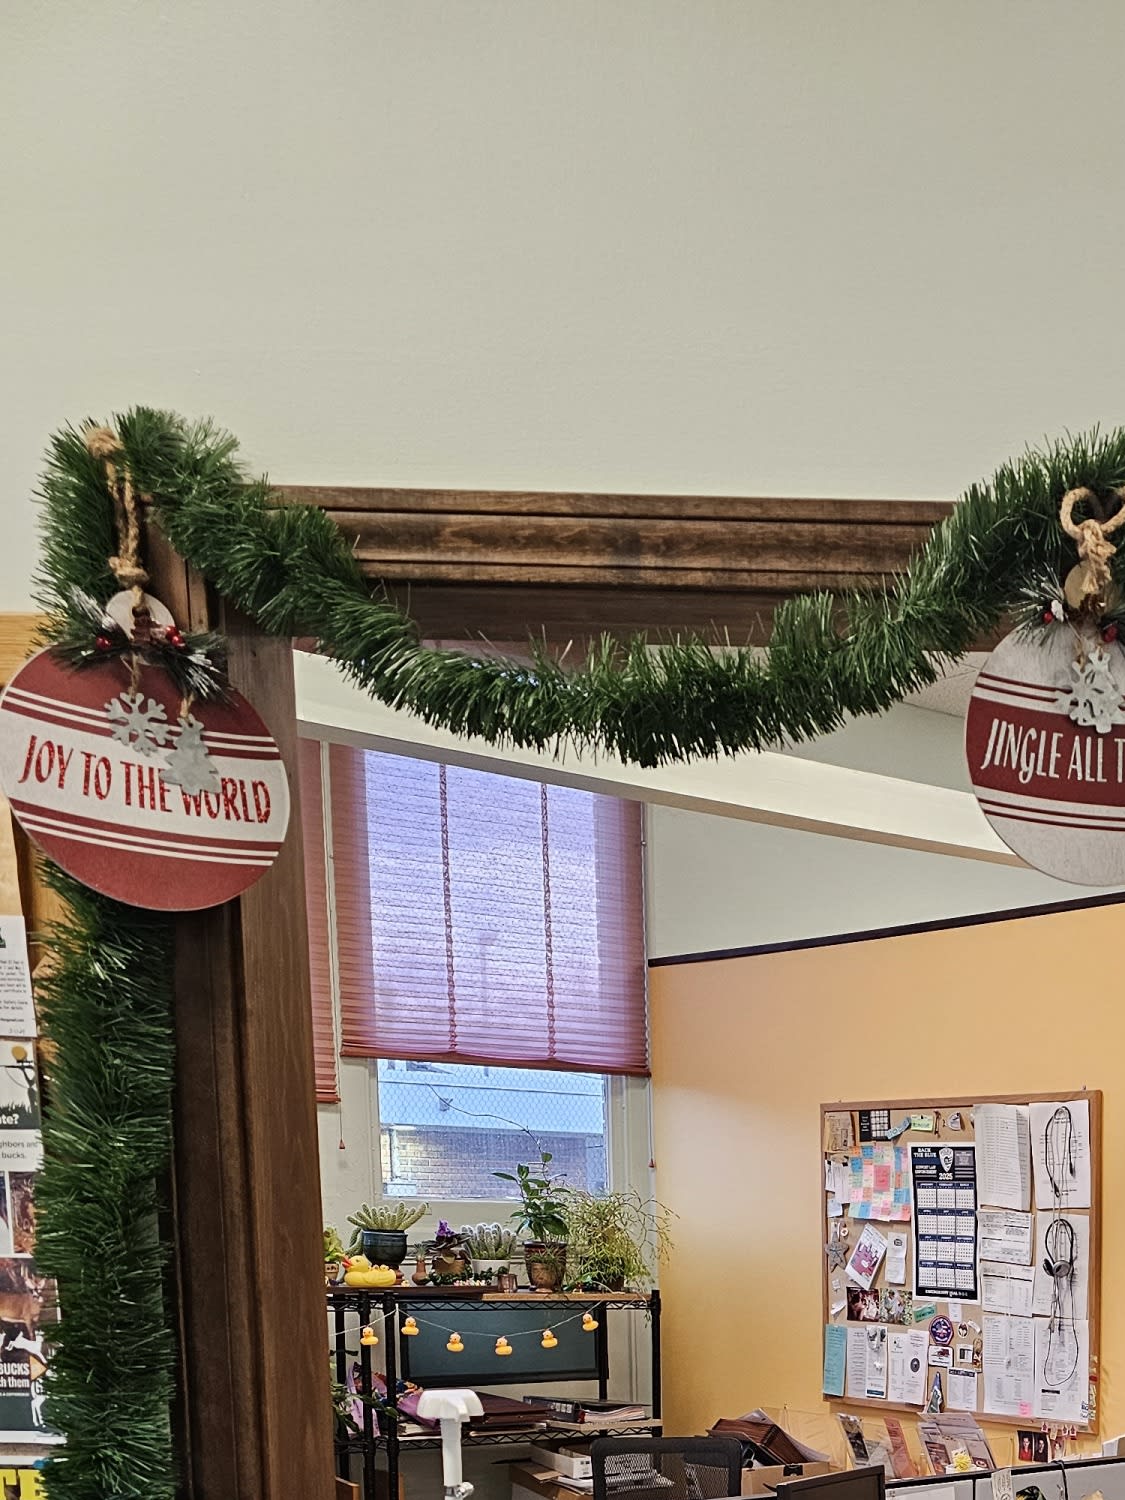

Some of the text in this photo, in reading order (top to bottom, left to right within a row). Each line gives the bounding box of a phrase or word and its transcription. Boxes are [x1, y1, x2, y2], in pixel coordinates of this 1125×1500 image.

[980, 718, 1064, 784] JINGLE
[1068, 735, 1107, 783] ALL
[18, 735, 73, 790] JOY
[81, 750, 112, 800] TO
[120, 761, 172, 812] THE
[938, 1172, 954, 1180] 2025
[8, 1375, 30, 1388] them
